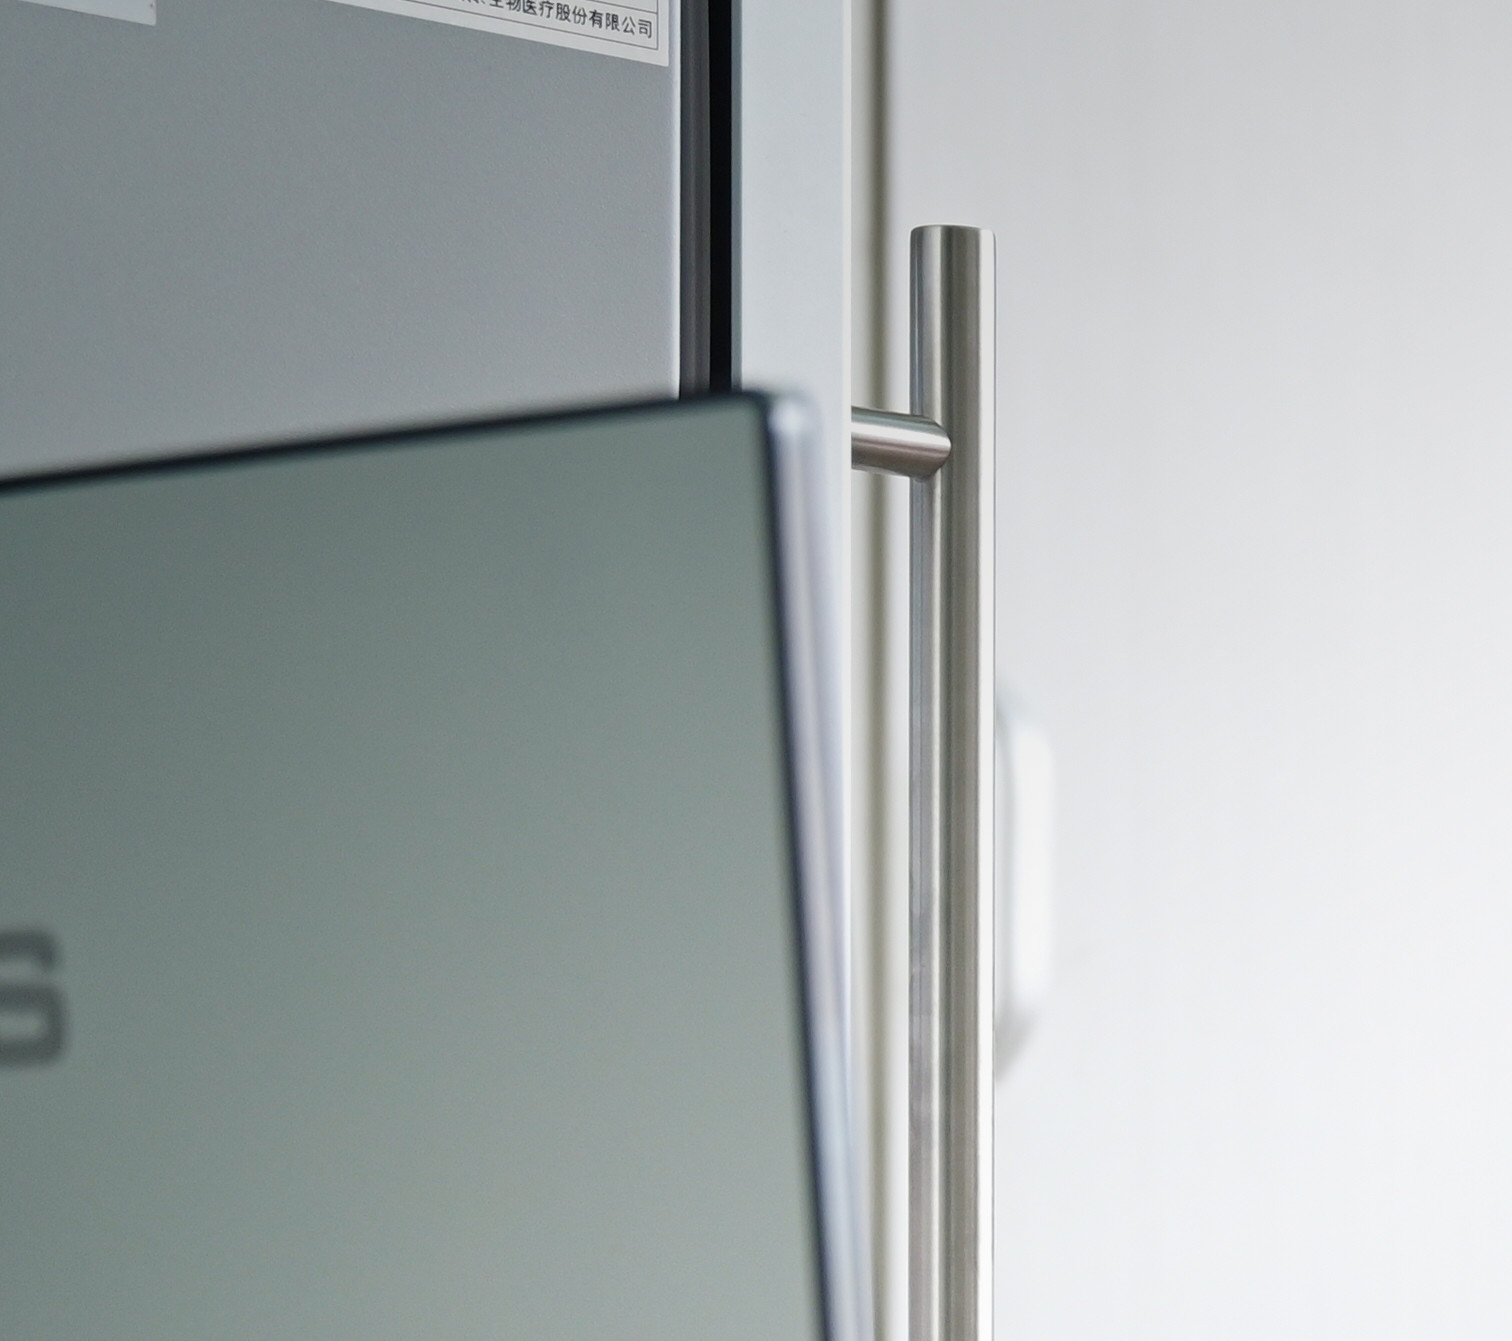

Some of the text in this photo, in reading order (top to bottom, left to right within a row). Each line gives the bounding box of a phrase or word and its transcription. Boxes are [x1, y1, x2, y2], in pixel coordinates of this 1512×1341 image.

[462, 0, 653, 39] 物医疗股份有限公司
